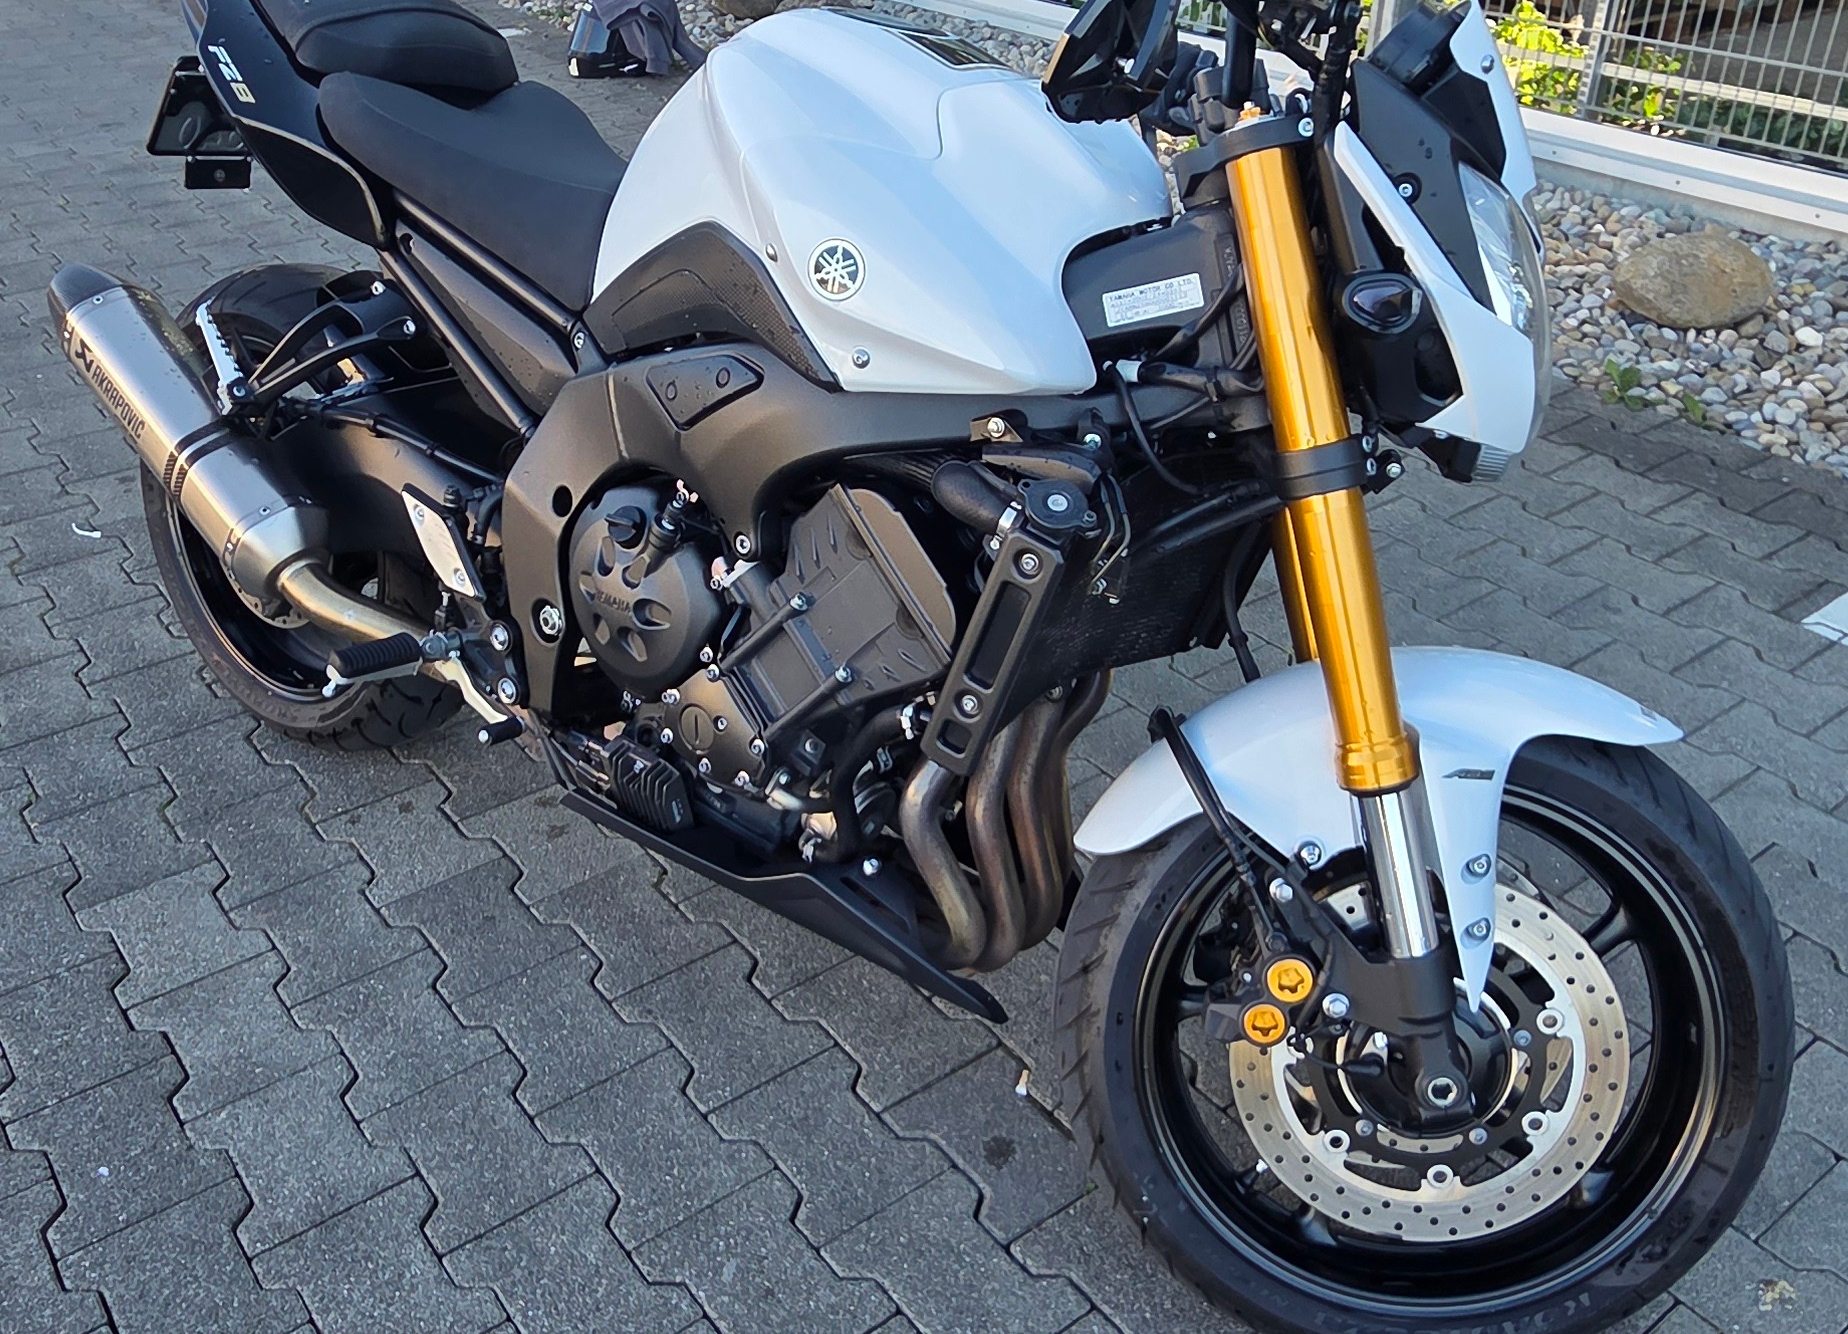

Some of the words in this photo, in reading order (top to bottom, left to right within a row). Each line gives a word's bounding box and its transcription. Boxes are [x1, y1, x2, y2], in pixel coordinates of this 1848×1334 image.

[207, 45, 256, 104] FZ8
[1109, 290, 1135, 303] YAMAHA
[1139, 285, 1161, 296] MOTOR
